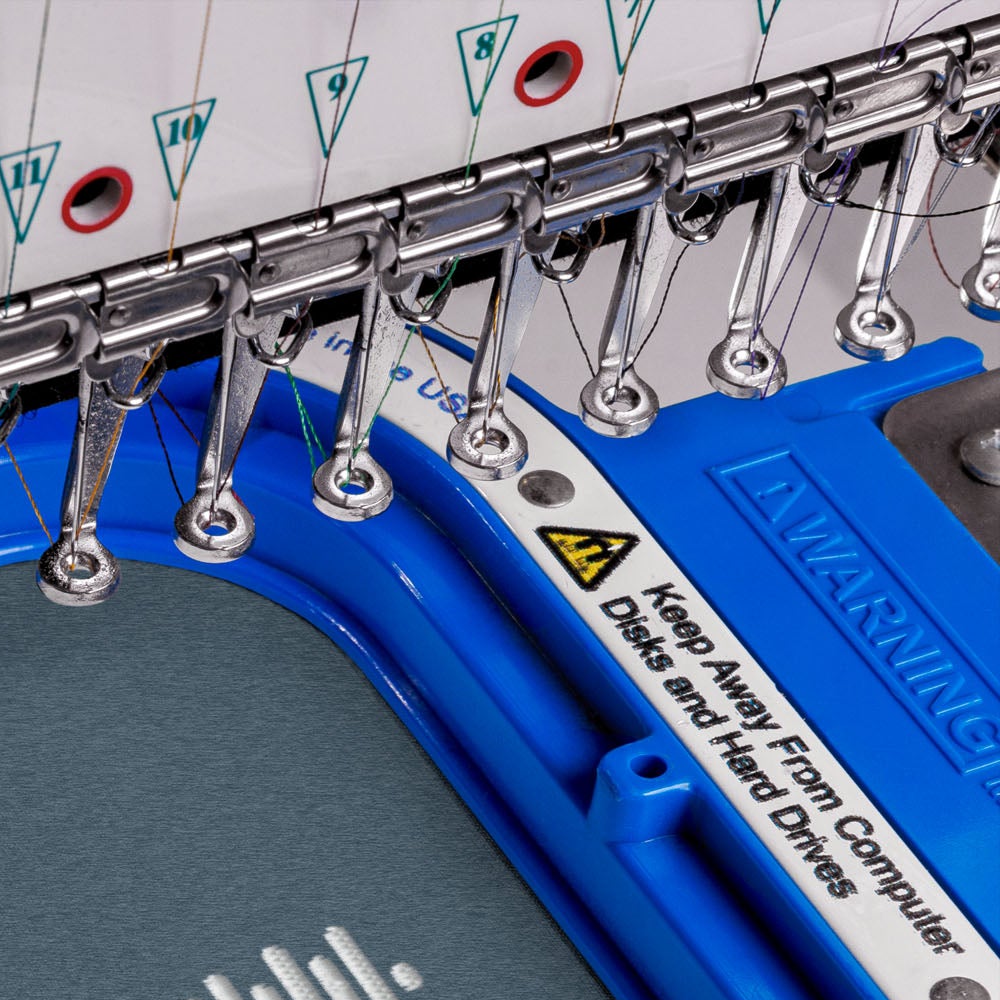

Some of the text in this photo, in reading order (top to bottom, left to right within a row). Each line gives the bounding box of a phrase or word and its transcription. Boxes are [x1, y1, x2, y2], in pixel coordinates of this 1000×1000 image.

[473, 31, 497, 61] 8
[327, 72, 349, 101] 9
[164, 113, 204, 148] 10
[9, 156, 45, 190] 11
[417, 377, 469, 420] US
[780, 510, 1000, 756] WARNING
[598, 595, 859, 900] Disks and Hard Drives
[641, 582, 966, 956] Keep Away From Computer
